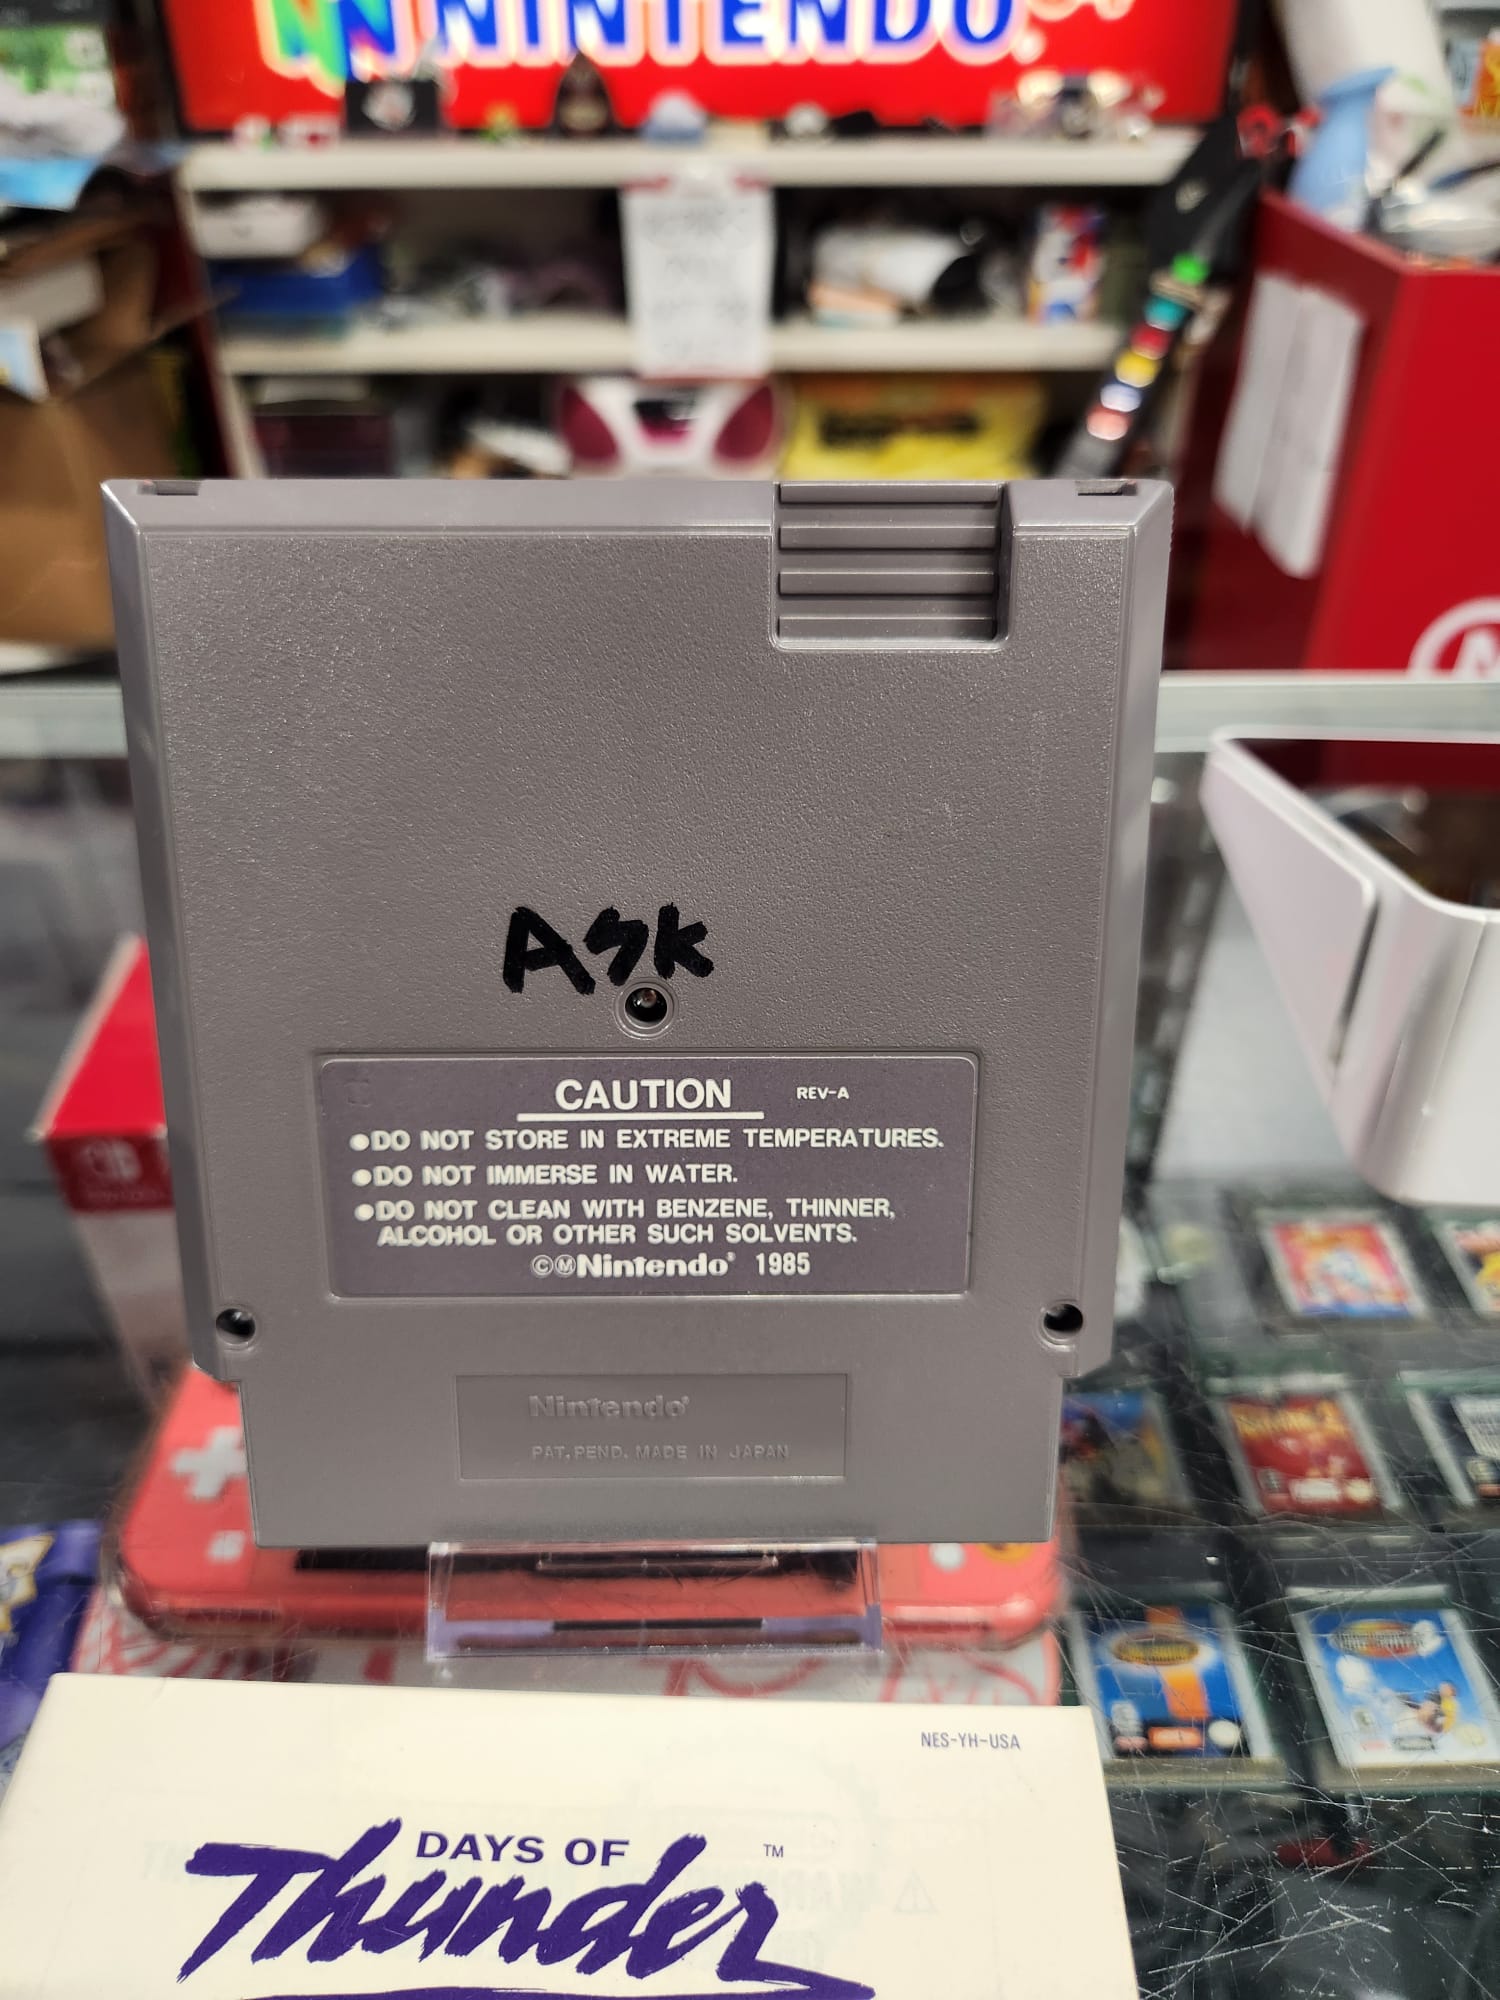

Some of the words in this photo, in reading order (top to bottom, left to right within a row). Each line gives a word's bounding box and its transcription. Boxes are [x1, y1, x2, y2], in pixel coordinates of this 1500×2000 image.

[555, 1078, 732, 1110] CAUTION
[796, 1086, 850, 1101] REV-A
[371, 1129, 410, 1151] DO
[420, 1129, 474, 1151] NOT
[485, 1129, 568, 1150] STORE
[580, 1129, 604, 1149] IN
[617, 1128, 730, 1149] EXTREME
[743, 1127, 944, 1148] TEMPERATURES.
[373, 1165, 412, 1187] DO
[422, 1165, 476, 1186] NOT
[486, 1164, 597, 1185] IMMERSE
[609, 1164, 633, 1184] IN
[645, 1163, 738, 1184] WATER.
[375, 1200, 414, 1221] DO
[424, 1200, 477, 1221] NOT
[488, 1199, 570, 1220] CLEAN
[582, 1199, 644, 1219] WITH
[657, 1198, 773, 1221] BENZENE,
[786, 1197, 896, 1220] THINNER,
[377, 1224, 497, 1247] ALCOHOL
[507, 1224, 542, 1245] OR
[553, 1223, 636, 1245] OTHER
[648, 1223, 713, 1244] SUCH
[726, 1222, 857, 1244] SOLVENTS.
[755, 1251, 811, 1276] 1985
[635, 1444, 689, 1460] MADE
[699, 1444, 718, 1460] IN
[729, 1444, 790, 1460] JAPAN
[920, 1731, 1021, 1751] NES-YH-USA
[414, 1830, 545, 1864] DAYS
[564, 1837, 630, 1867] OF
[176, 1816, 875, 1999] Thunder
